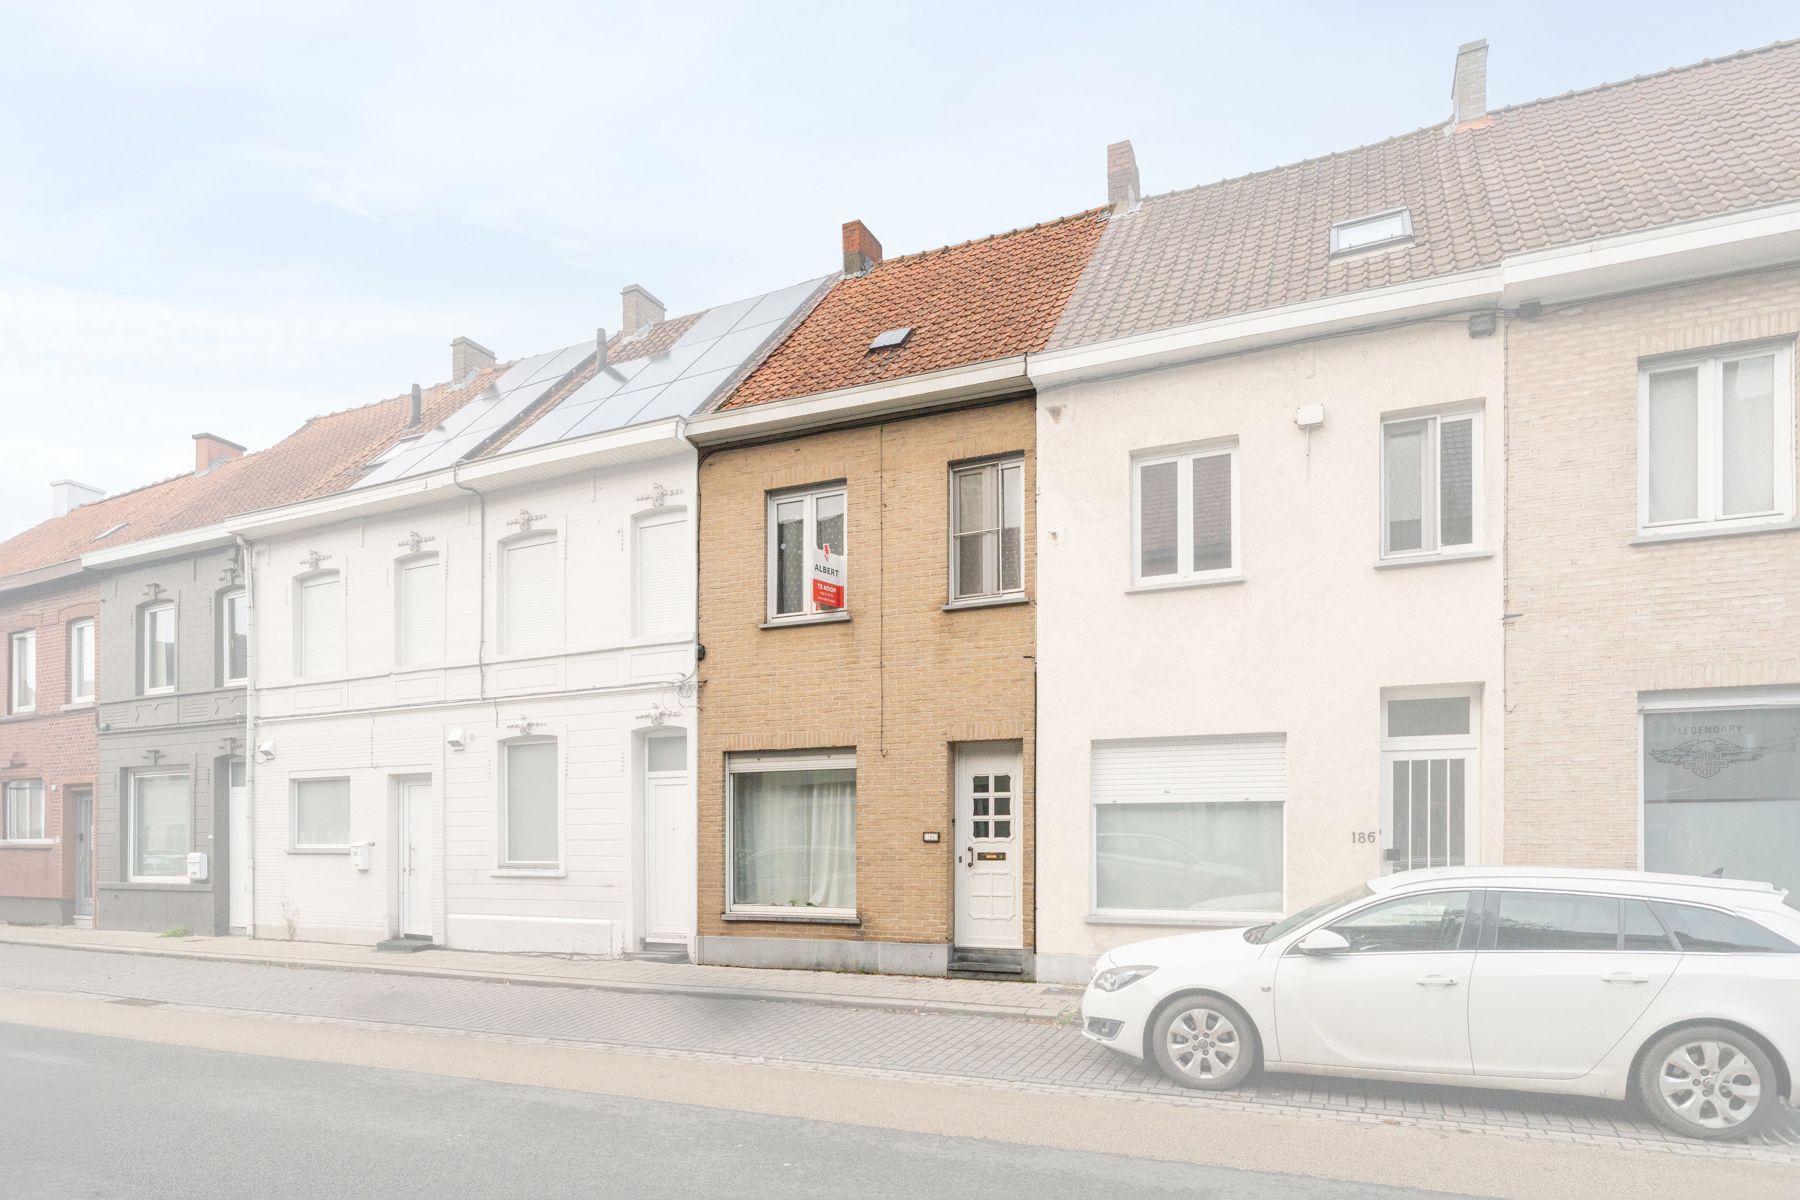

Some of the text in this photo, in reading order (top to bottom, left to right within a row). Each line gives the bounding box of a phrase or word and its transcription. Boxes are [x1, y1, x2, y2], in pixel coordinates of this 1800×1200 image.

[814, 564, 839, 577] ALBERT
[1678, 724, 1742, 735] LEGENDARY
[1351, 831, 1376, 844] 186
